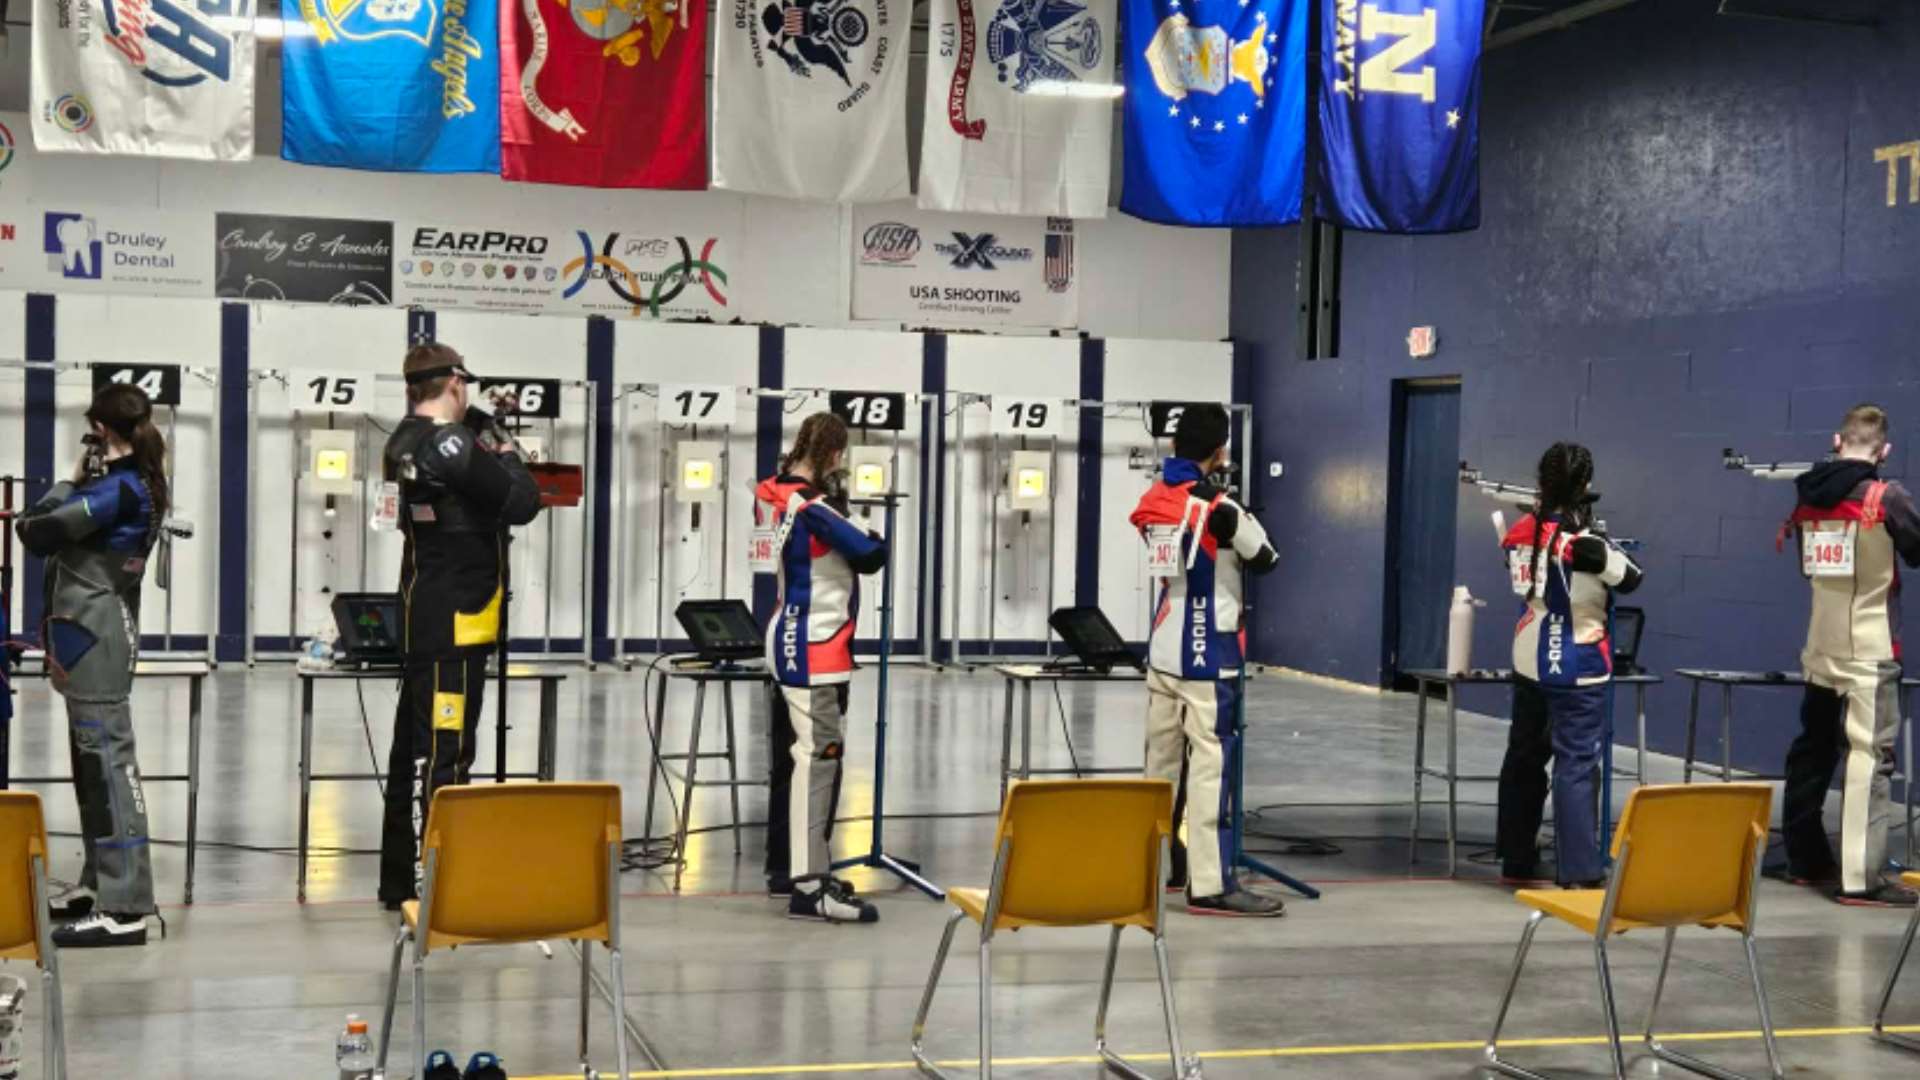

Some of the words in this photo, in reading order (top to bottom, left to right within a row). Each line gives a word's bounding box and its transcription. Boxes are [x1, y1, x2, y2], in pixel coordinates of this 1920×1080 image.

[940, 23, 955, 57] 1775
[1334, 0, 1357, 101] NAVY
[1360, 3, 1437, 103] N
[871, 37, 889, 75] COAST
[837, 81, 871, 112] GUARD
[951, 75, 966, 122] ARMY
[106, 232, 168, 250] Druley
[951, 231, 998, 270] X
[114, 252, 175, 268] Dental
[910, 285, 940, 300] USA
[944, 287, 1021, 303] SHOOTING
[309, 376, 357, 405] 15
[675, 391, 720, 418] 17
[846, 397, 891, 424] 18
[1007, 403, 1048, 428] 19
[1815, 543, 1844, 564] 149
[1192, 597, 1207, 667] USCGA
[1548, 613, 1564, 674] USCGA
